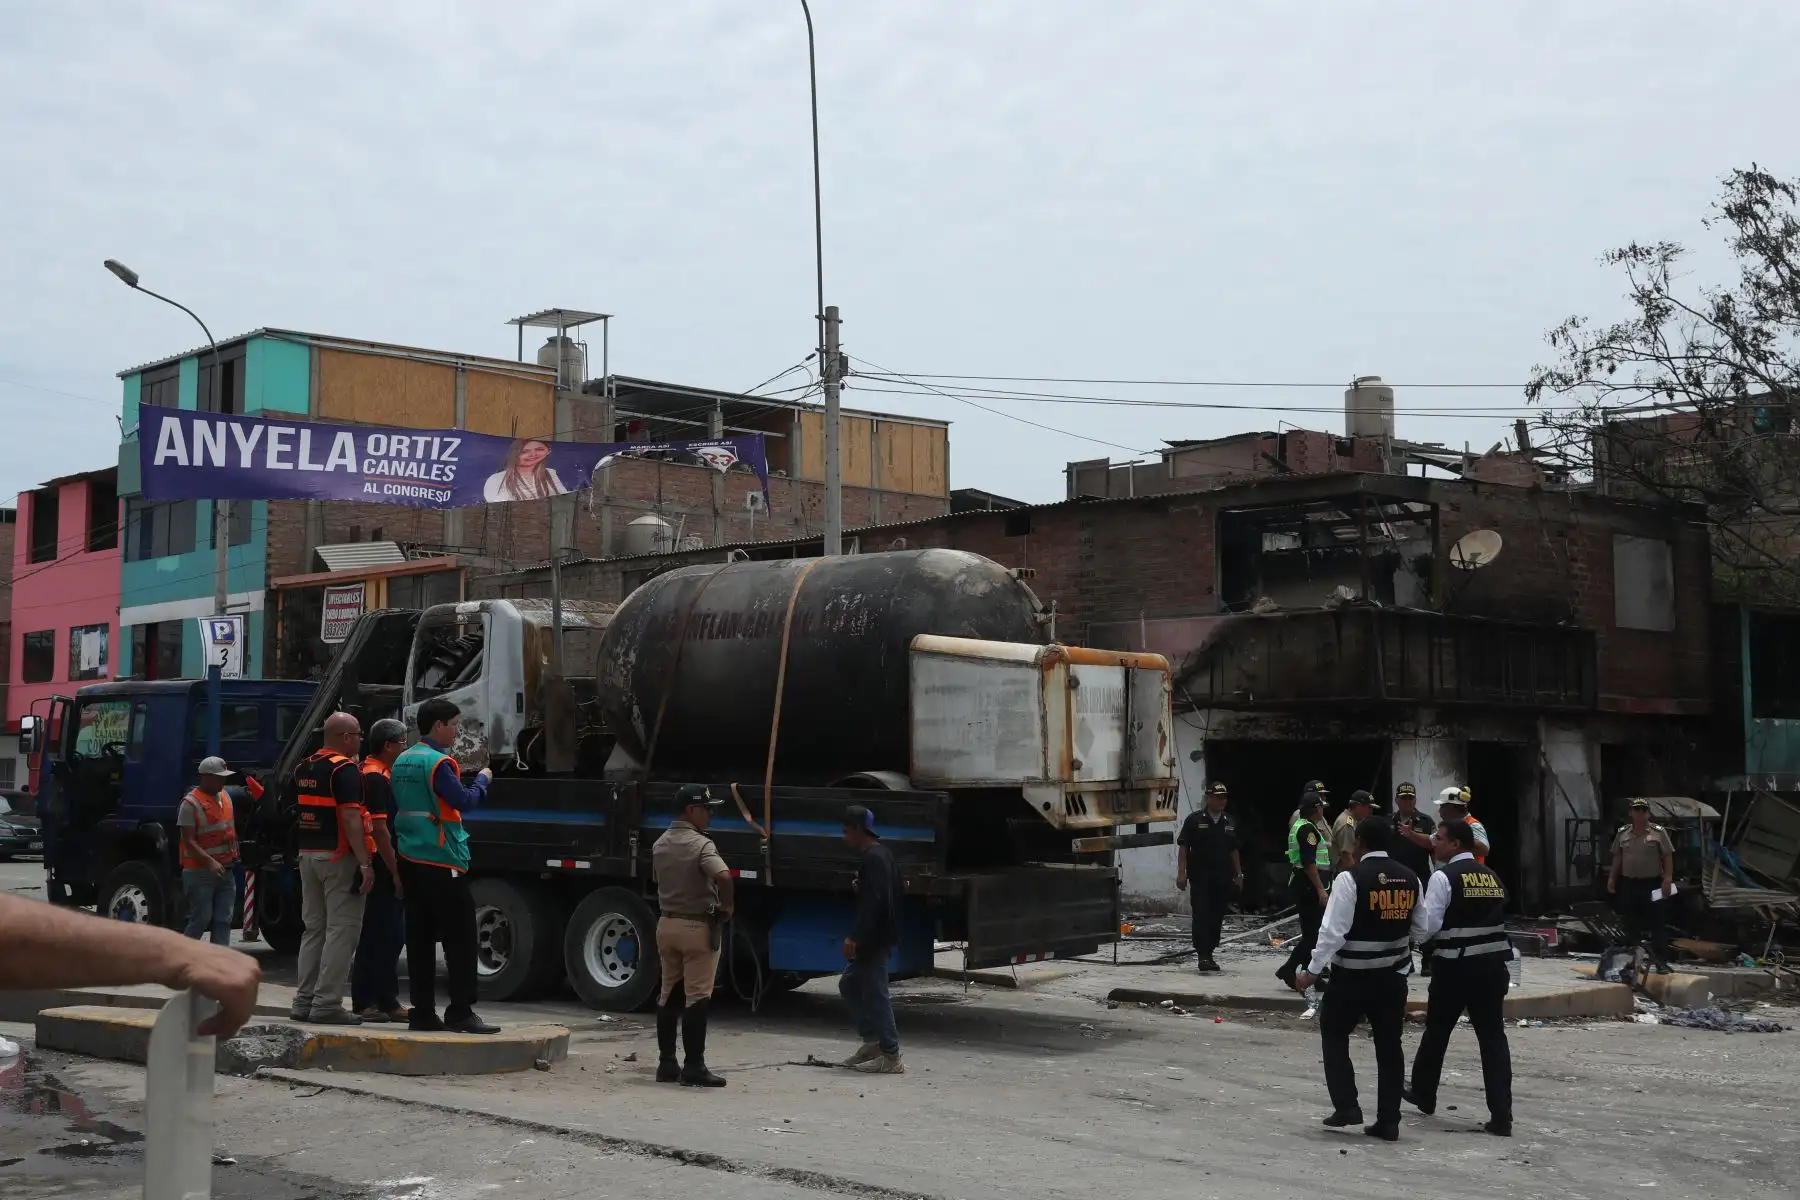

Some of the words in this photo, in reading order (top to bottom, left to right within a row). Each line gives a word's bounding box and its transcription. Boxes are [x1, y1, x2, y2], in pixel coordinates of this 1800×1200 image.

[153, 416, 357, 473] ANYELA
[367, 433, 462, 462] ORTIZ
[363, 458, 455, 482] CANALES
[363, 482, 381, 494] AL
[385, 483, 451, 503] CONGRESO
[219, 648, 229, 669] 3
